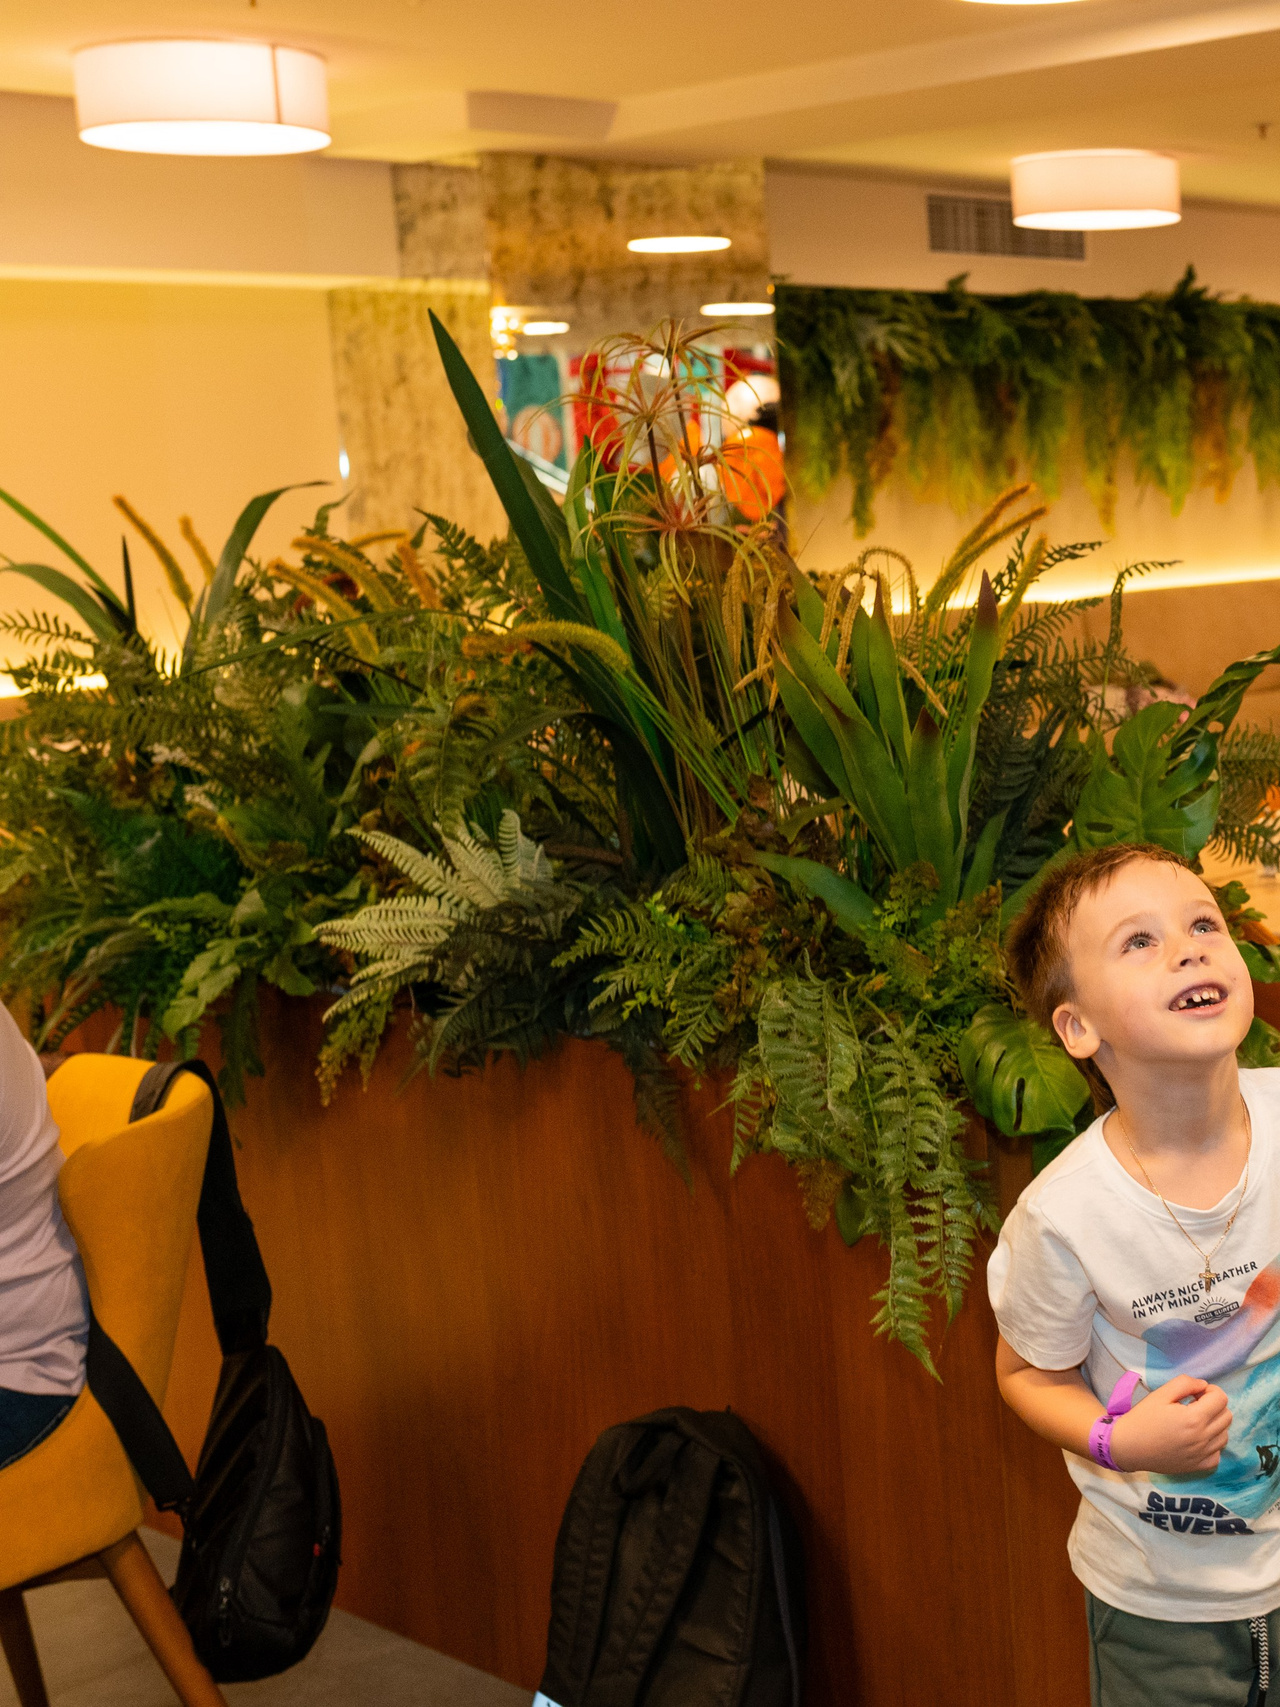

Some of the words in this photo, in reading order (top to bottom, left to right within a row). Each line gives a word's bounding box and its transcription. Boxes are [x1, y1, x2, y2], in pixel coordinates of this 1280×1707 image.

[1131, 1289, 1175, 1309] ALWAYS
[1178, 1280, 1204, 1296] NICE
[1133, 1308, 1146, 1319] IN
[1149, 1302, 1165, 1315] MY
[1168, 1294, 1200, 1310] MIND
[1196, 1311, 1214, 1322] SOUL
[1214, 1302, 1238, 1316] SURFER
[1146, 1491, 1230, 1518] SURF
[1138, 1511, 1255, 1535] FEVER
